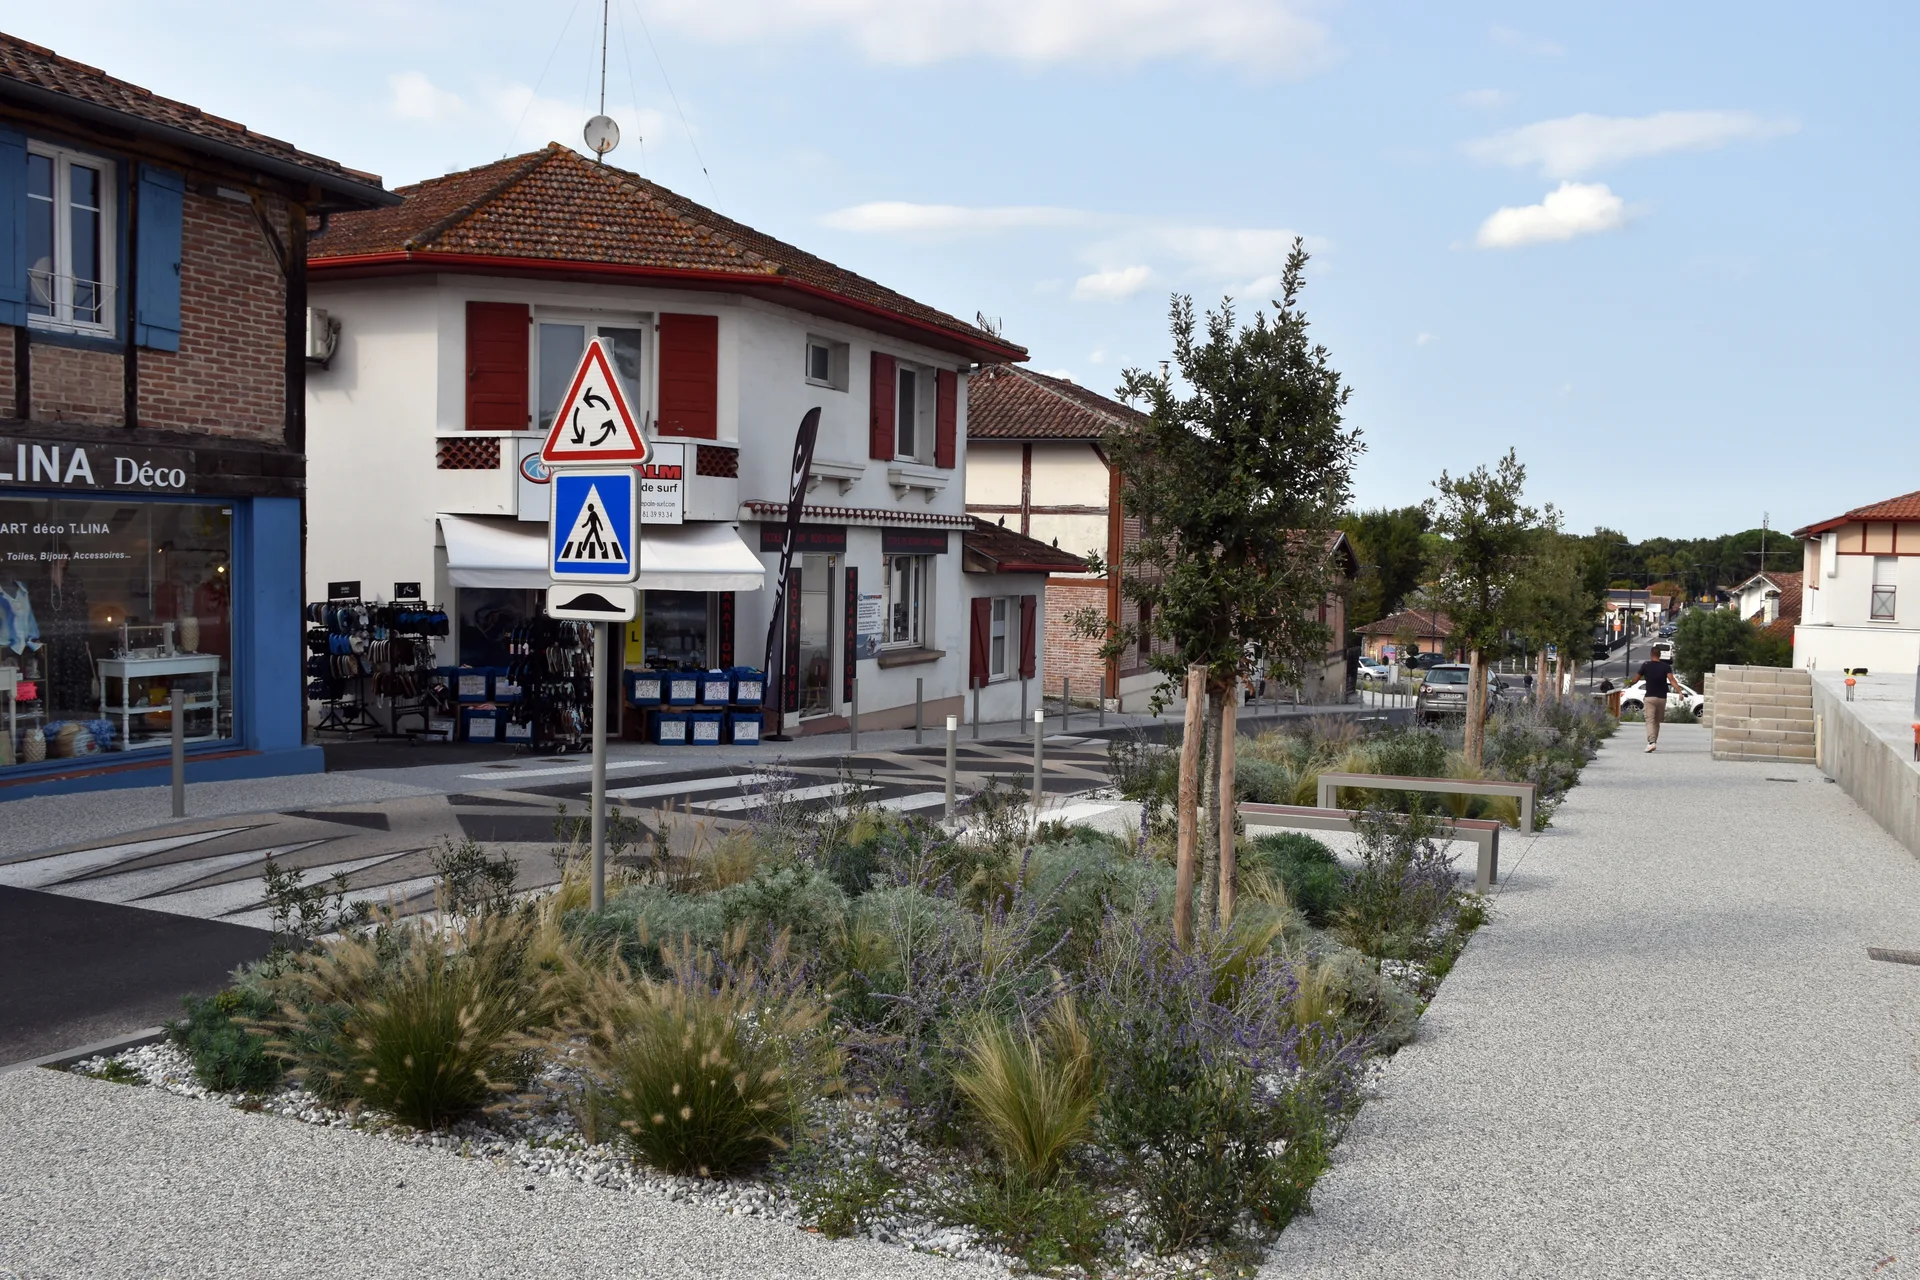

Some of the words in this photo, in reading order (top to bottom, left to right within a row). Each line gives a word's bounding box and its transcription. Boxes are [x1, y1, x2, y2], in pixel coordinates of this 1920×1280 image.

[0, 443, 95, 485] INA
[114, 457, 186, 488] Déco
[641, 483, 654, 492] de
[657, 483, 678, 492] surf
[0, 523, 28, 534] ART
[33, 522, 65, 534] déco
[69, 523, 110, 535] T.LINA
[7, 552, 37, 562] Toiles,
[40, 552, 71, 562] Bijoux,
[789, 573, 798, 708] LOCATIONS
